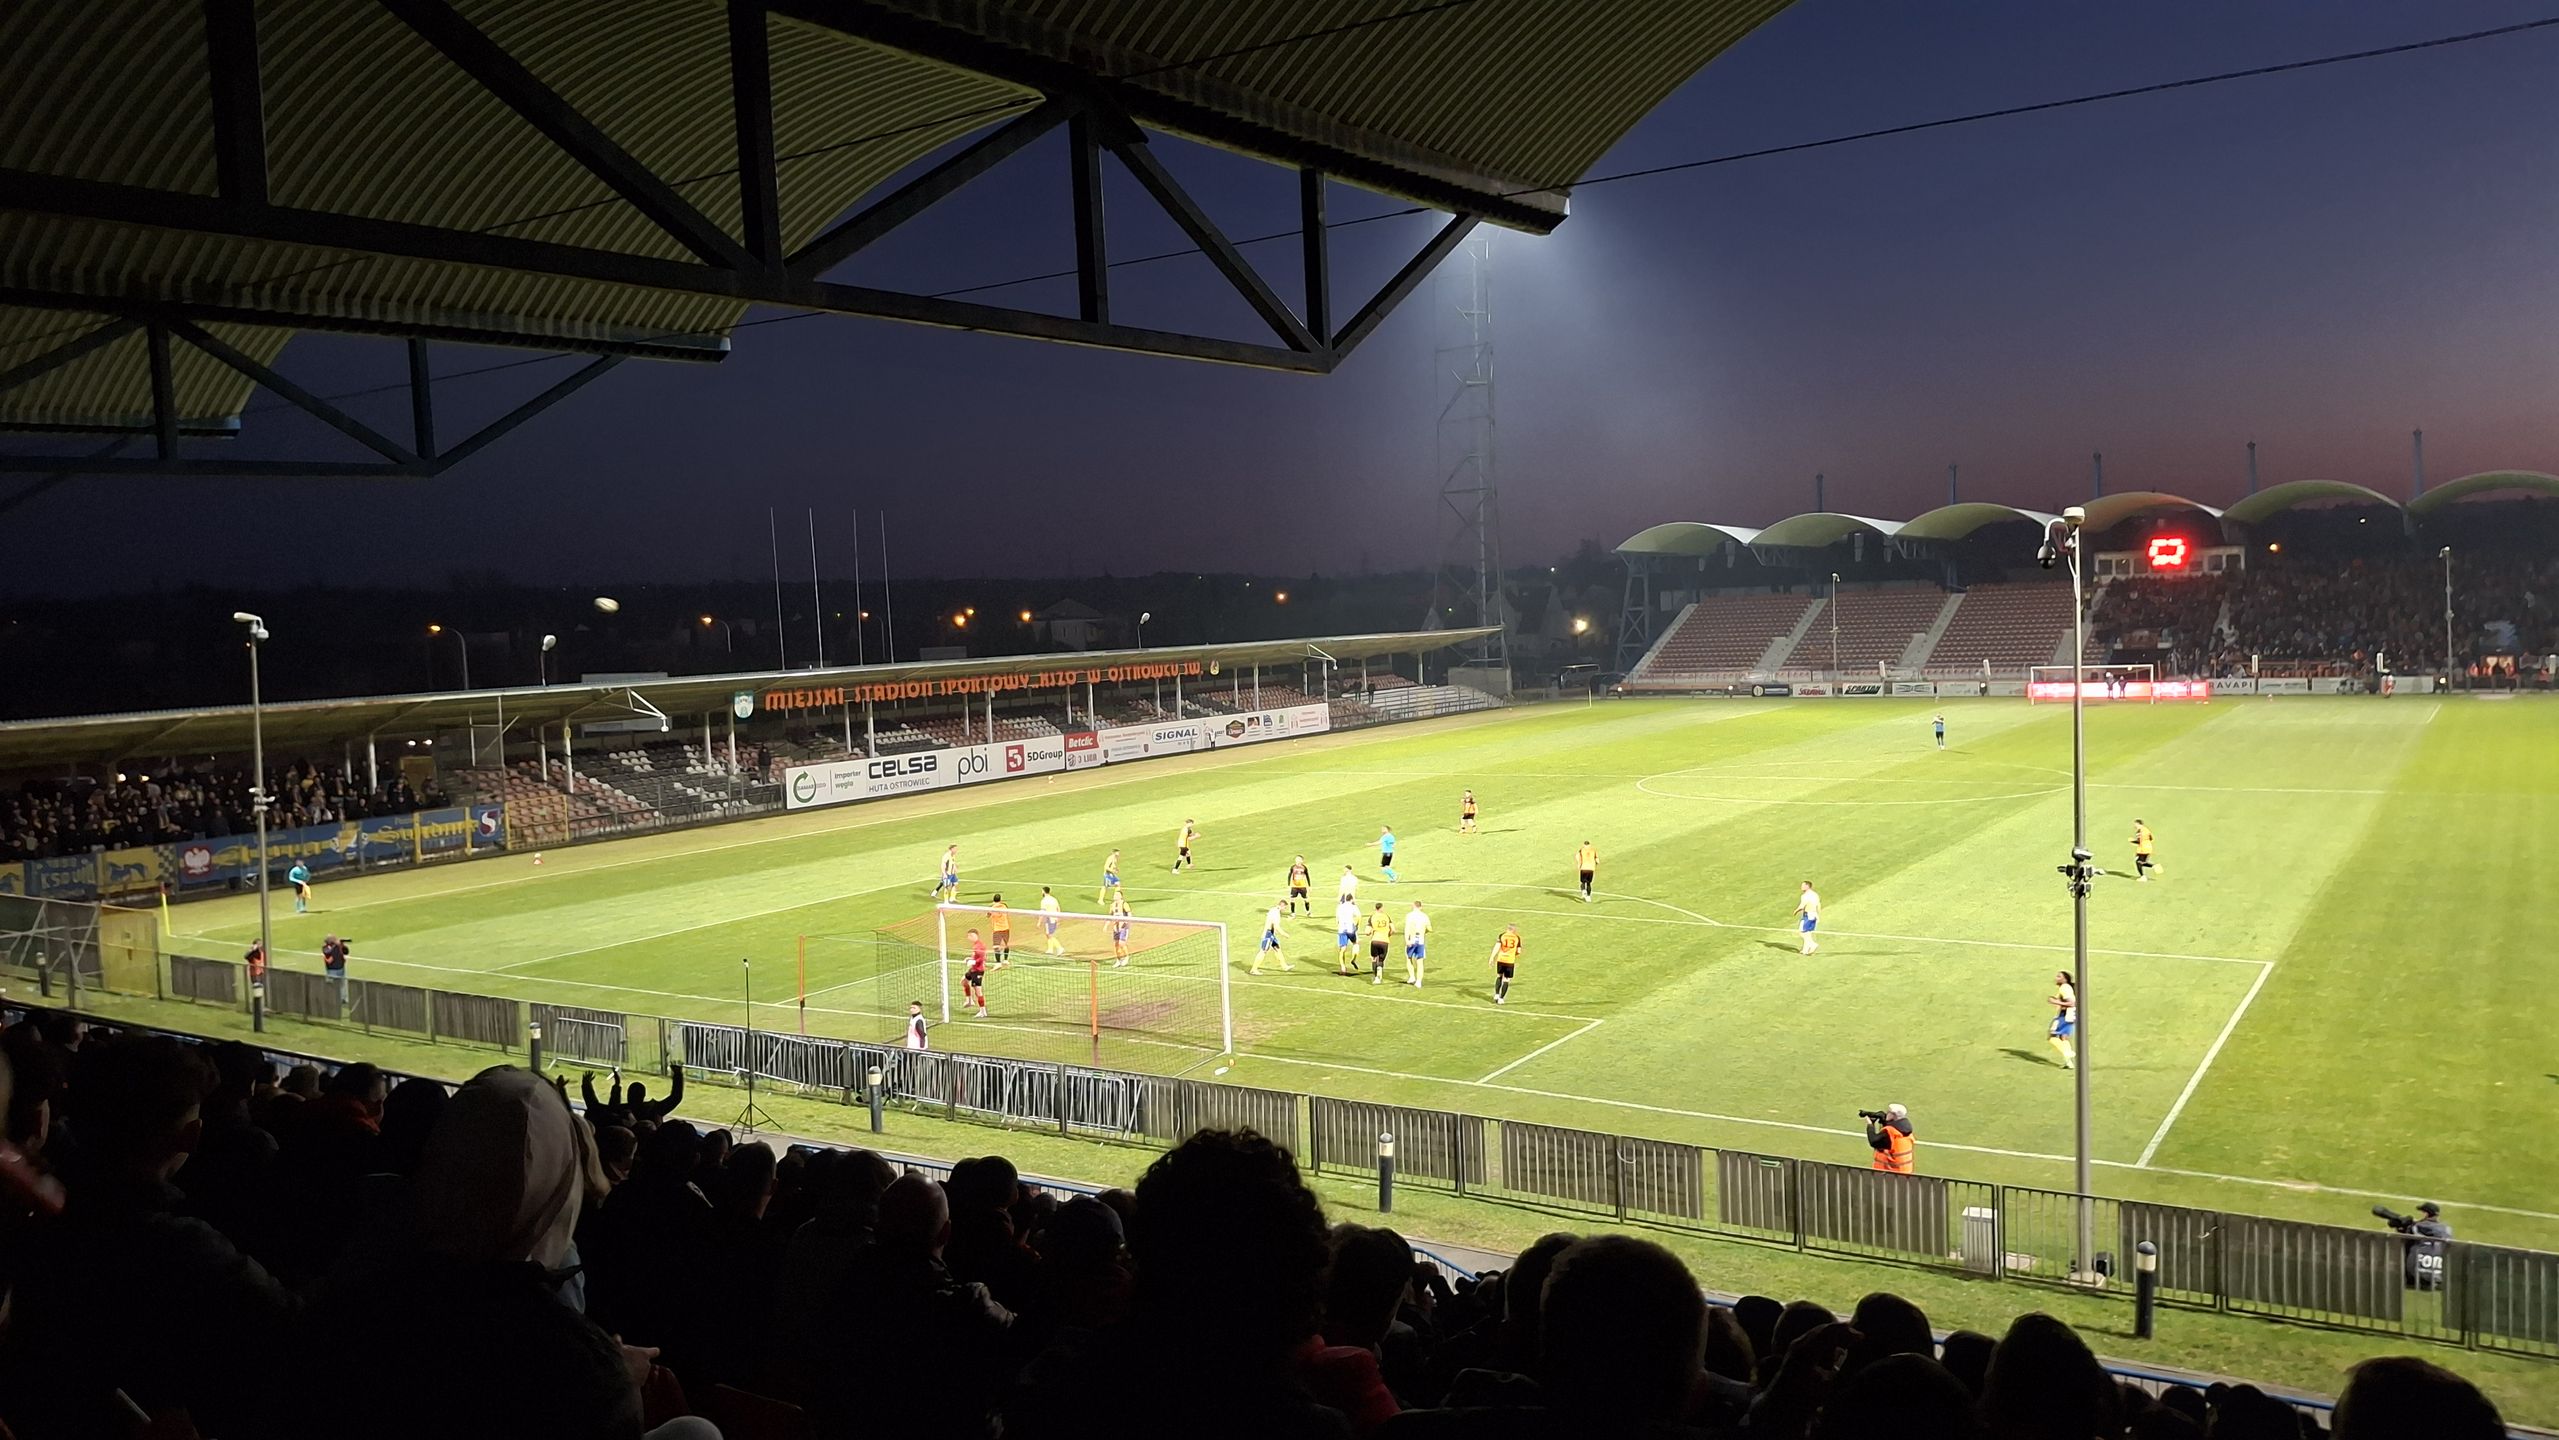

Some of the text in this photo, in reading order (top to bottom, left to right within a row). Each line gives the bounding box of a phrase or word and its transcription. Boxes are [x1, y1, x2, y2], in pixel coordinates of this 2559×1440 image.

[765, 688, 844, 711] MIEJSKI
[855, 681, 932, 704] STADION
[939, 673, 1029, 696] SPORTOWY
[1087, 668, 1101, 683] W
[1108, 663, 1179, 682] OSTROWCU
[1155, 728, 1198, 741] SIGNAL
[1068, 736, 1093, 749] Betclic
[958, 747, 988, 783] pbi
[868, 778, 930, 793] HUTA OSTROWIEC
[1504, 939, 1515, 948] 13
